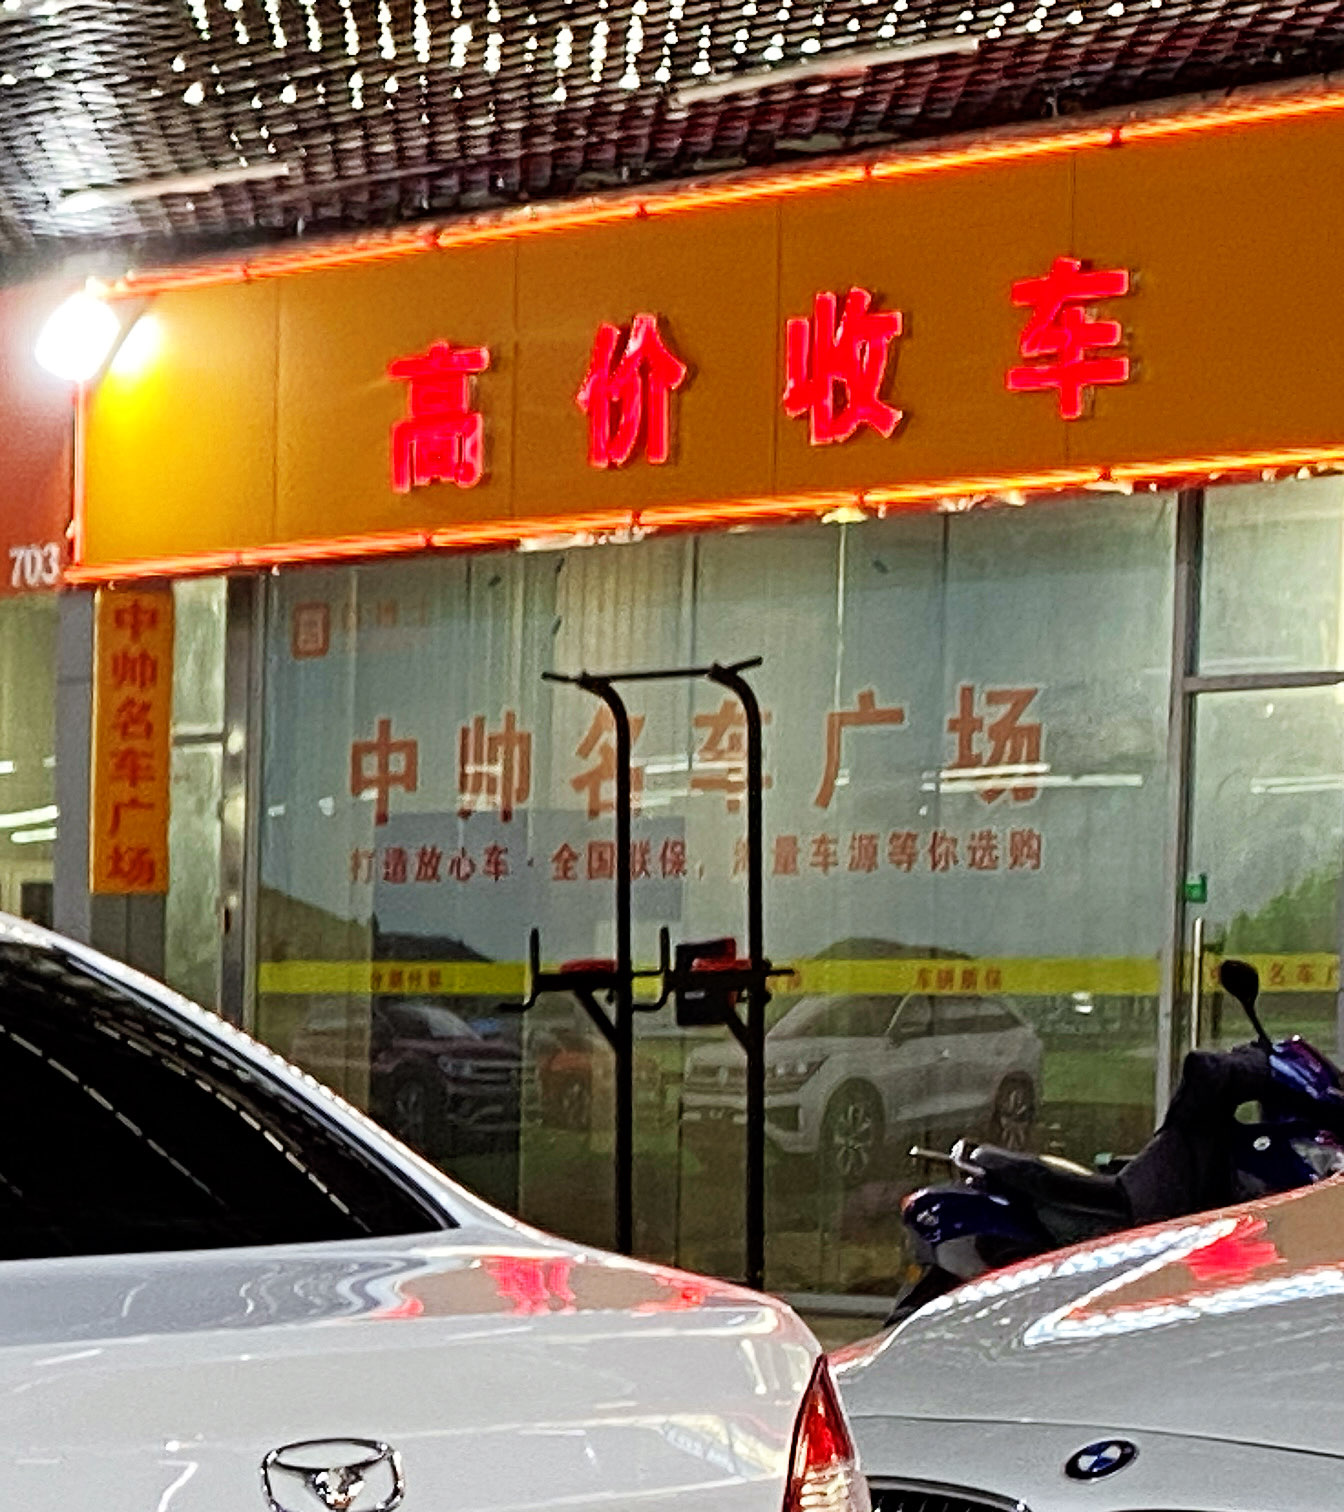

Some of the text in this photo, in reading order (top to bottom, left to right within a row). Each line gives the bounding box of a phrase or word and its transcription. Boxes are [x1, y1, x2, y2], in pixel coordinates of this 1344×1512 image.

[389, 257, 1128, 492] 高价收车
[9, 542, 60, 587] 703
[108, 600, 158, 886] 中帅名车广场
[350, 685, 1042, 827] 中帅名车广场
